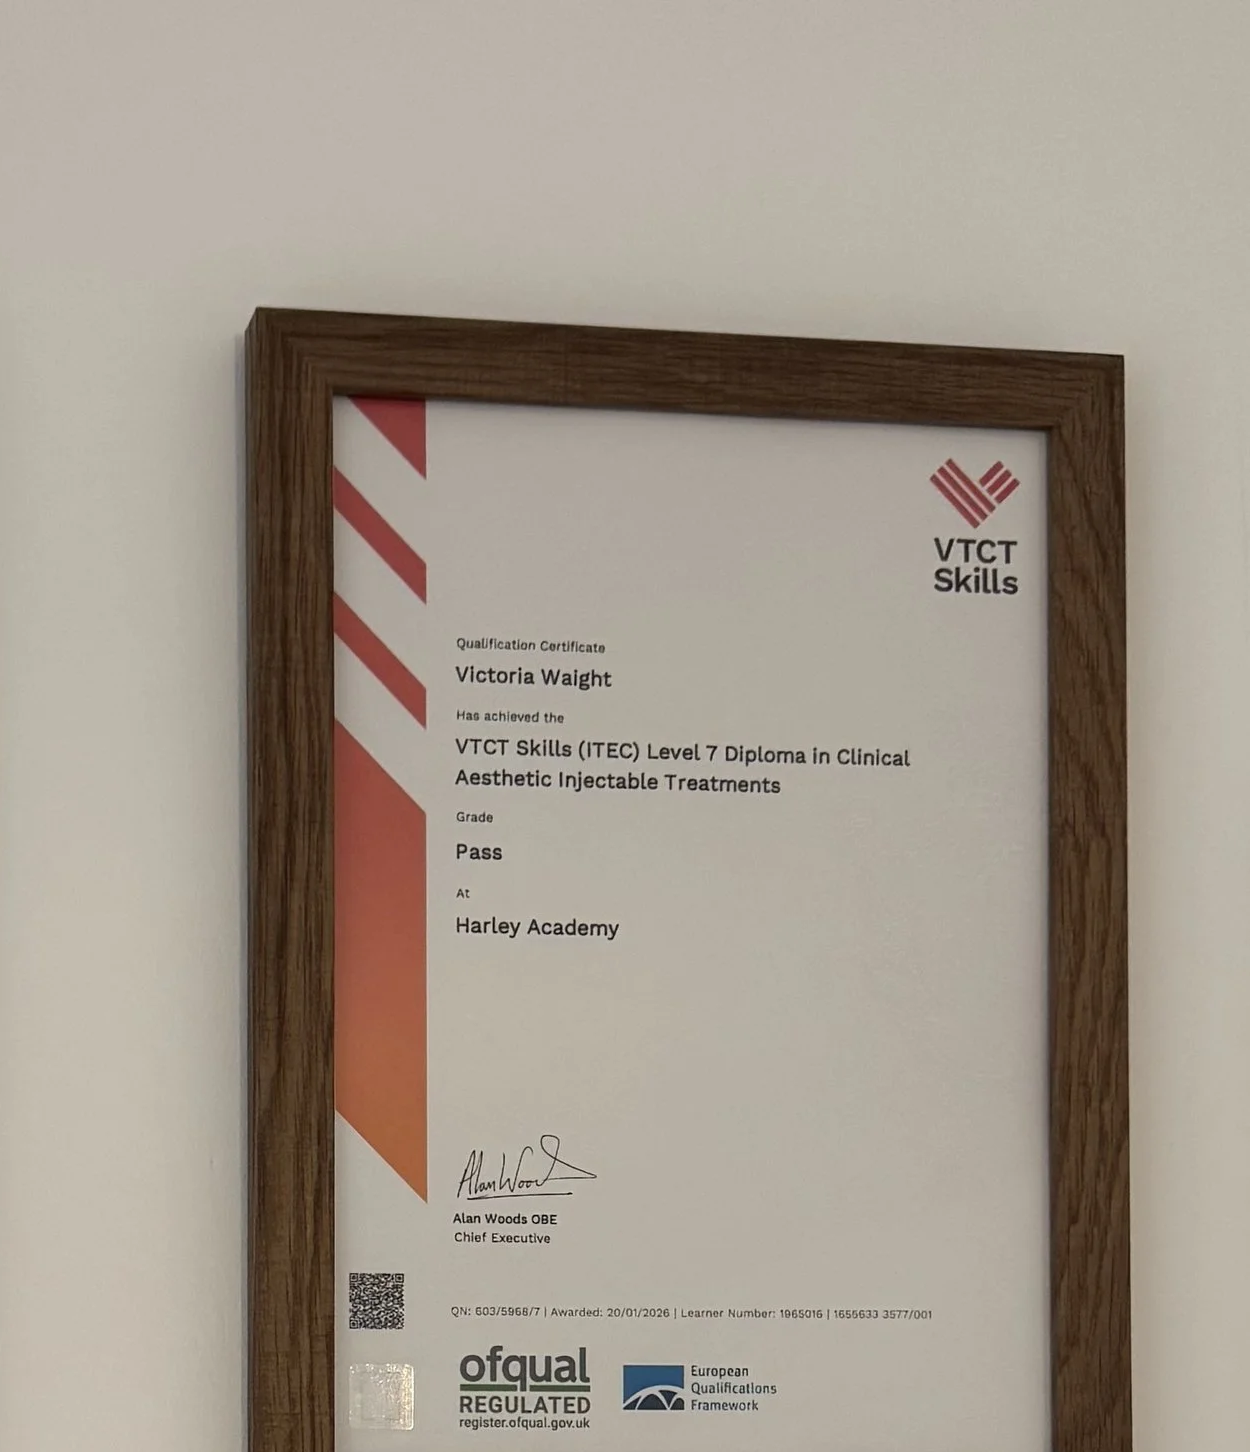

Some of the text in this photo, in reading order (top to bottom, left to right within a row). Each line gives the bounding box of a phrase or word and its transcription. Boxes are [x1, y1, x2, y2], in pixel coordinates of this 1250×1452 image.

[933, 536, 1018, 565] VTCT
[933, 566, 1019, 596] Skills
[456, 637, 606, 654] Qualification Certificate
[455, 665, 613, 691] Victoria Waight
[456, 709, 565, 724] Has achieved the
[455, 737, 911, 768] VTCT Skills (ITEC) Level 7 Diploma in Clinical
[454, 768, 781, 794] Aesthetic Injectable Treatments
[456, 811, 494, 824] Grade
[456, 843, 503, 861] Pass
[455, 888, 471, 899] At
[456, 916, 620, 941] Harley Academy
[452, 1212, 558, 1225] Alan Woods OBE
[454, 1231, 551, 1244] Chief Executive
[450, 1306, 472, 1318] QN:
[550, 1307, 604, 1318] Awarded:
[606, 1307, 671, 1318] 20/01/2026
[680, 1308, 724, 1318] Learner
[727, 1308, 776, 1319] Number:
[460, 1346, 590, 1391] ofqual
[690, 1364, 749, 1380] European
[690, 1381, 778, 1396] Qualifications
[459, 1395, 591, 1415] REGULATED
[691, 1399, 759, 1412] Framework
[459, 1415, 590, 1432] register.ofqual.gov.uk
